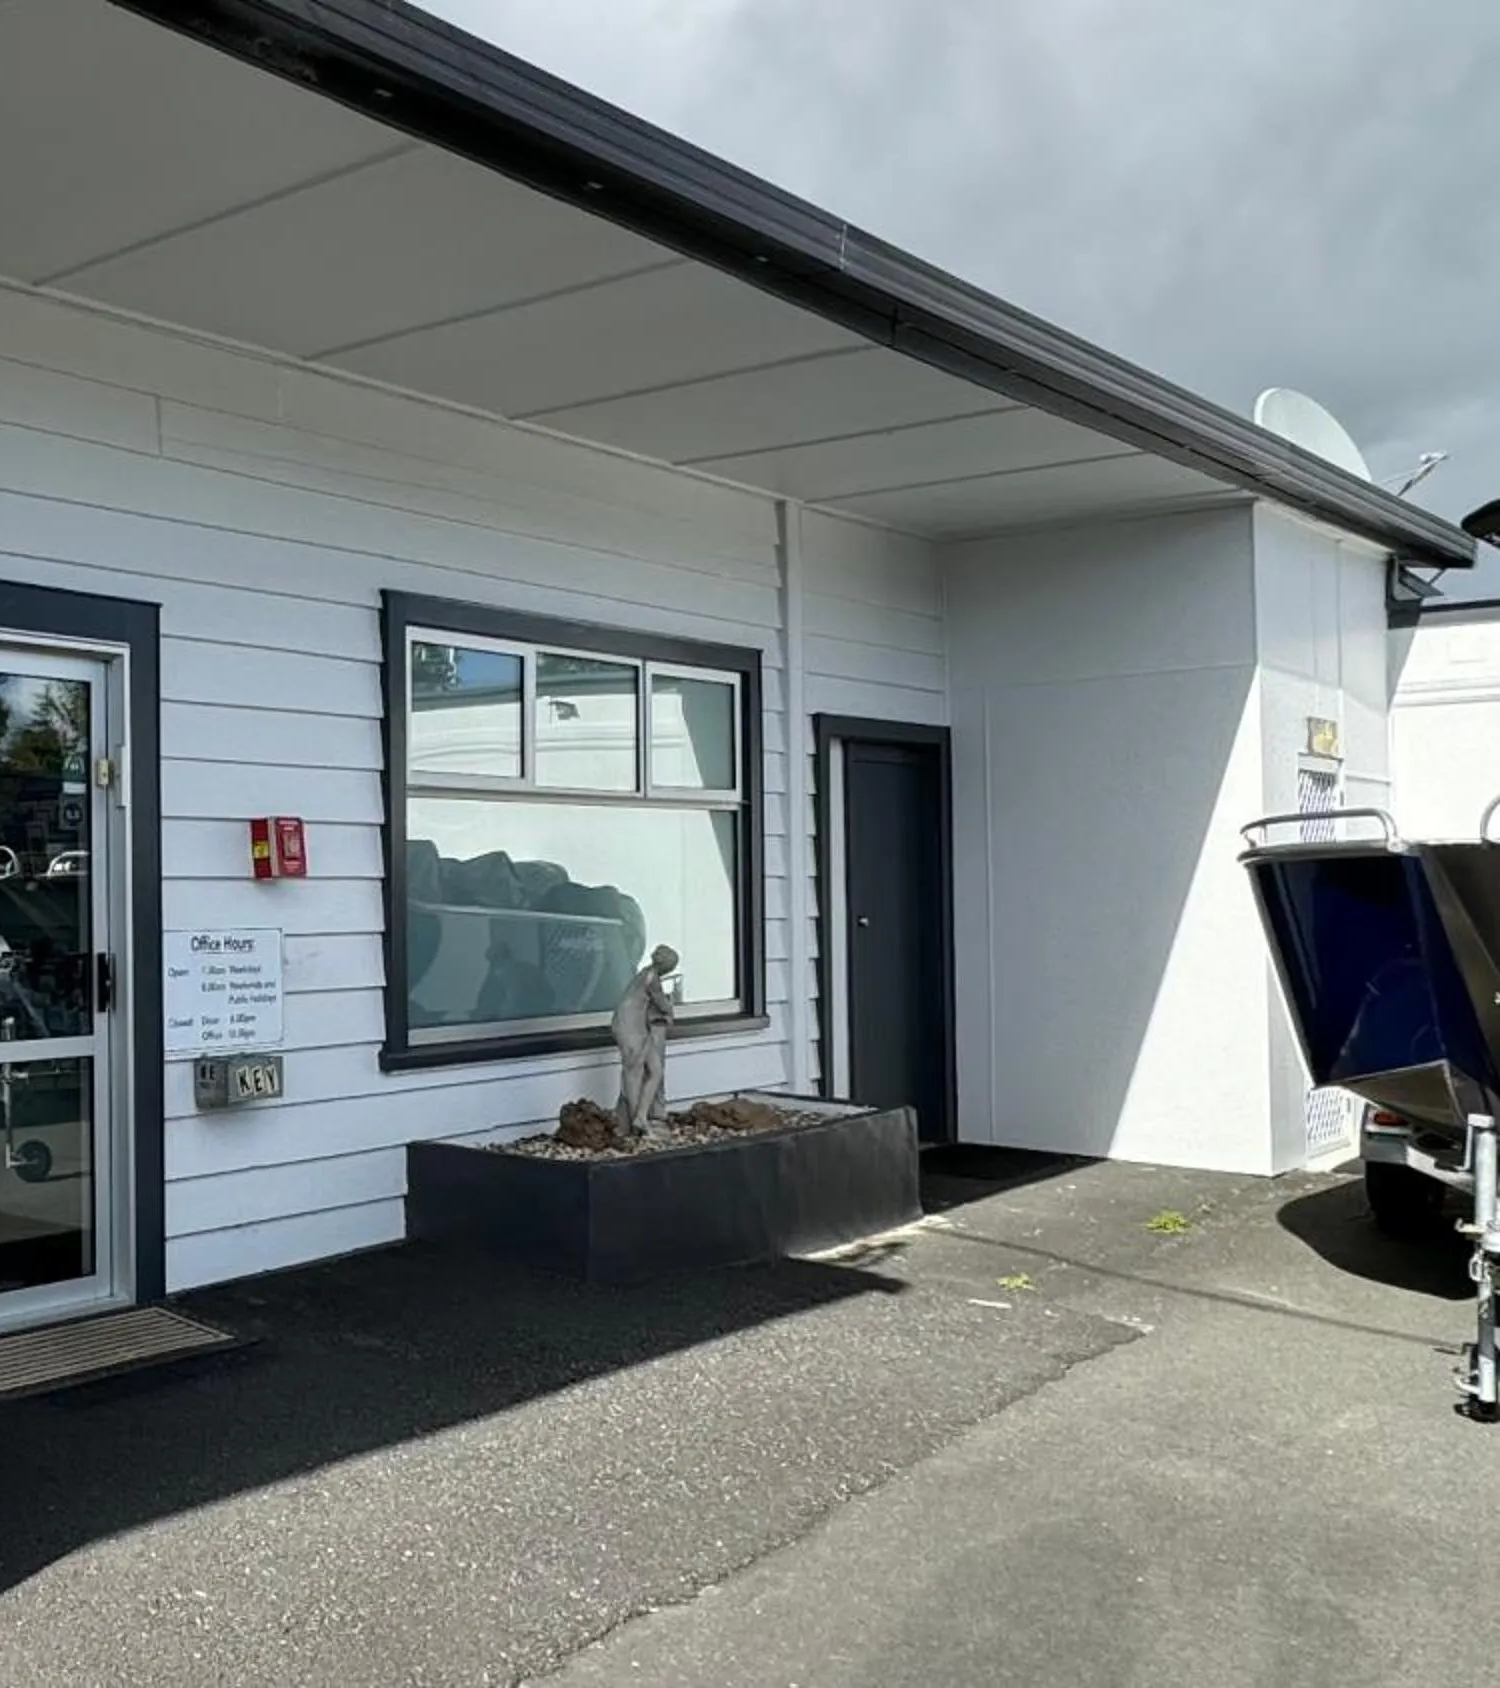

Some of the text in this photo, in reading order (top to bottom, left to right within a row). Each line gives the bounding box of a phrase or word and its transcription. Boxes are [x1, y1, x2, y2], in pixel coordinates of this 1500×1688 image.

[190, 935, 255, 952] Office Hours
[238, 1066, 278, 1094] KEY
